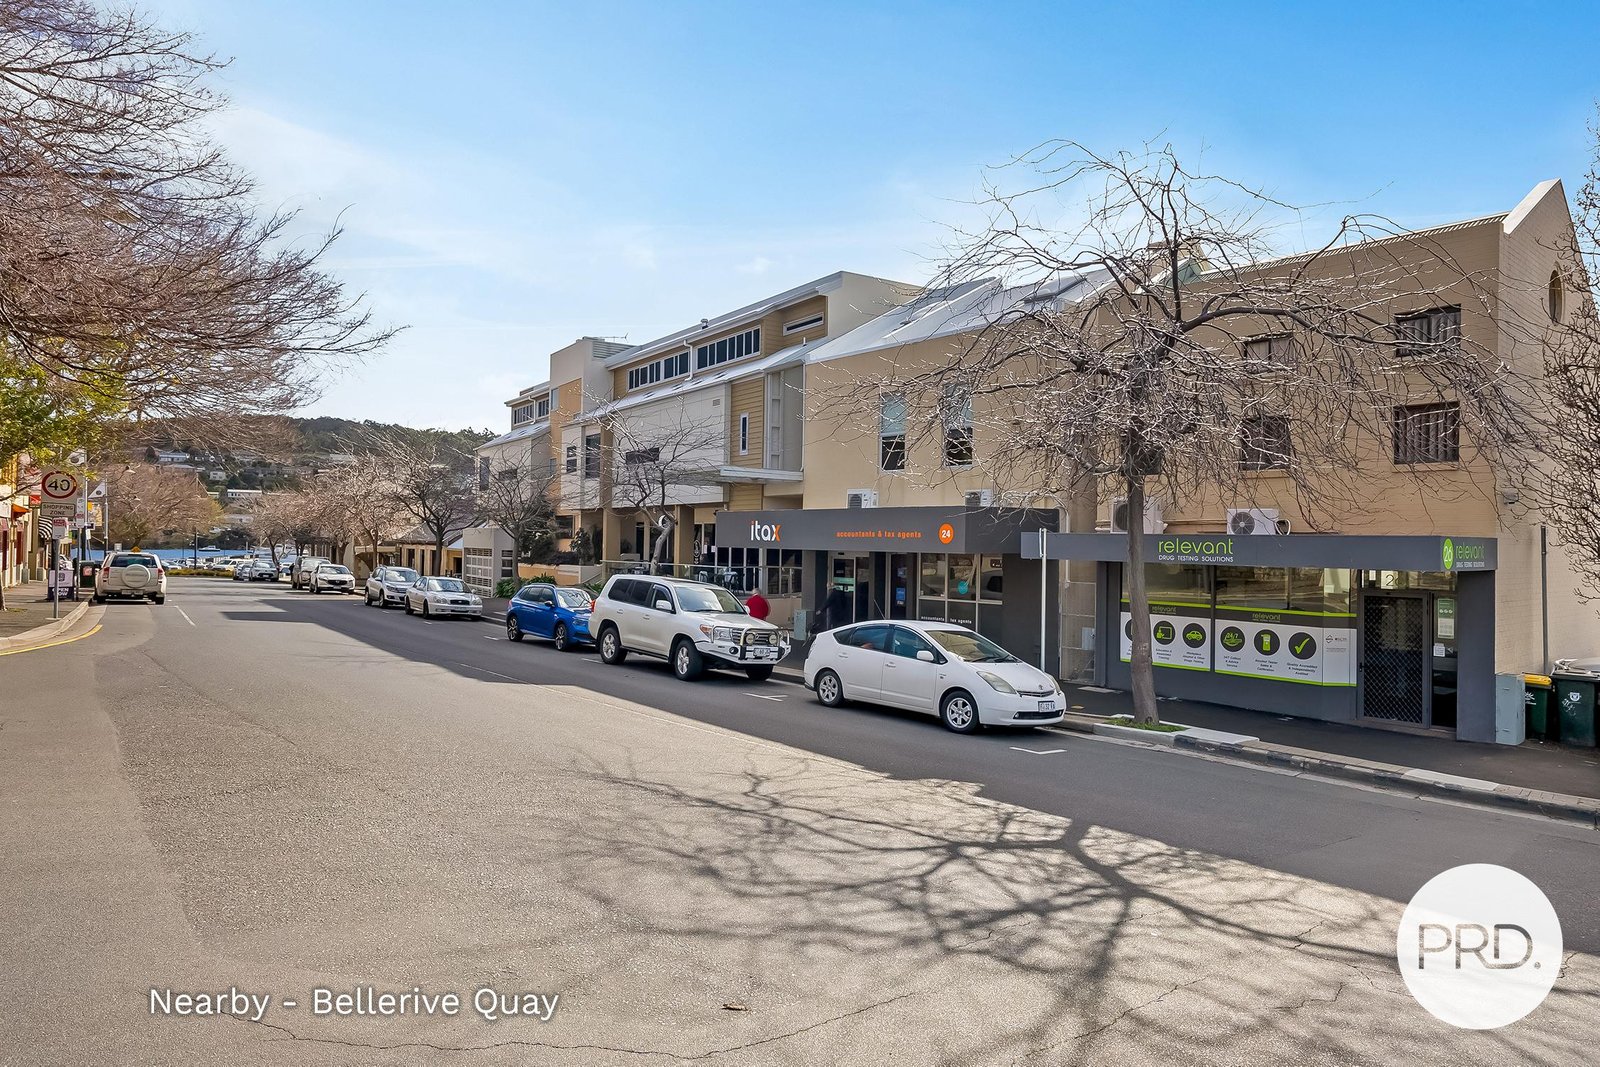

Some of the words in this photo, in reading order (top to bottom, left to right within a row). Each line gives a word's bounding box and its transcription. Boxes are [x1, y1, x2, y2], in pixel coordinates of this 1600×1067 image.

[48, 479, 70, 491] 40
[751, 520, 781, 541] itax
[836, 530, 876, 538] accountants
[884, 530, 895, 538] tax
[897, 531, 921, 539] agents
[941, 530, 951, 538] 24
[1158, 537, 1234, 555] relevant
[1443, 546, 1453, 561] 26
[1455, 542, 1484, 559] relevant
